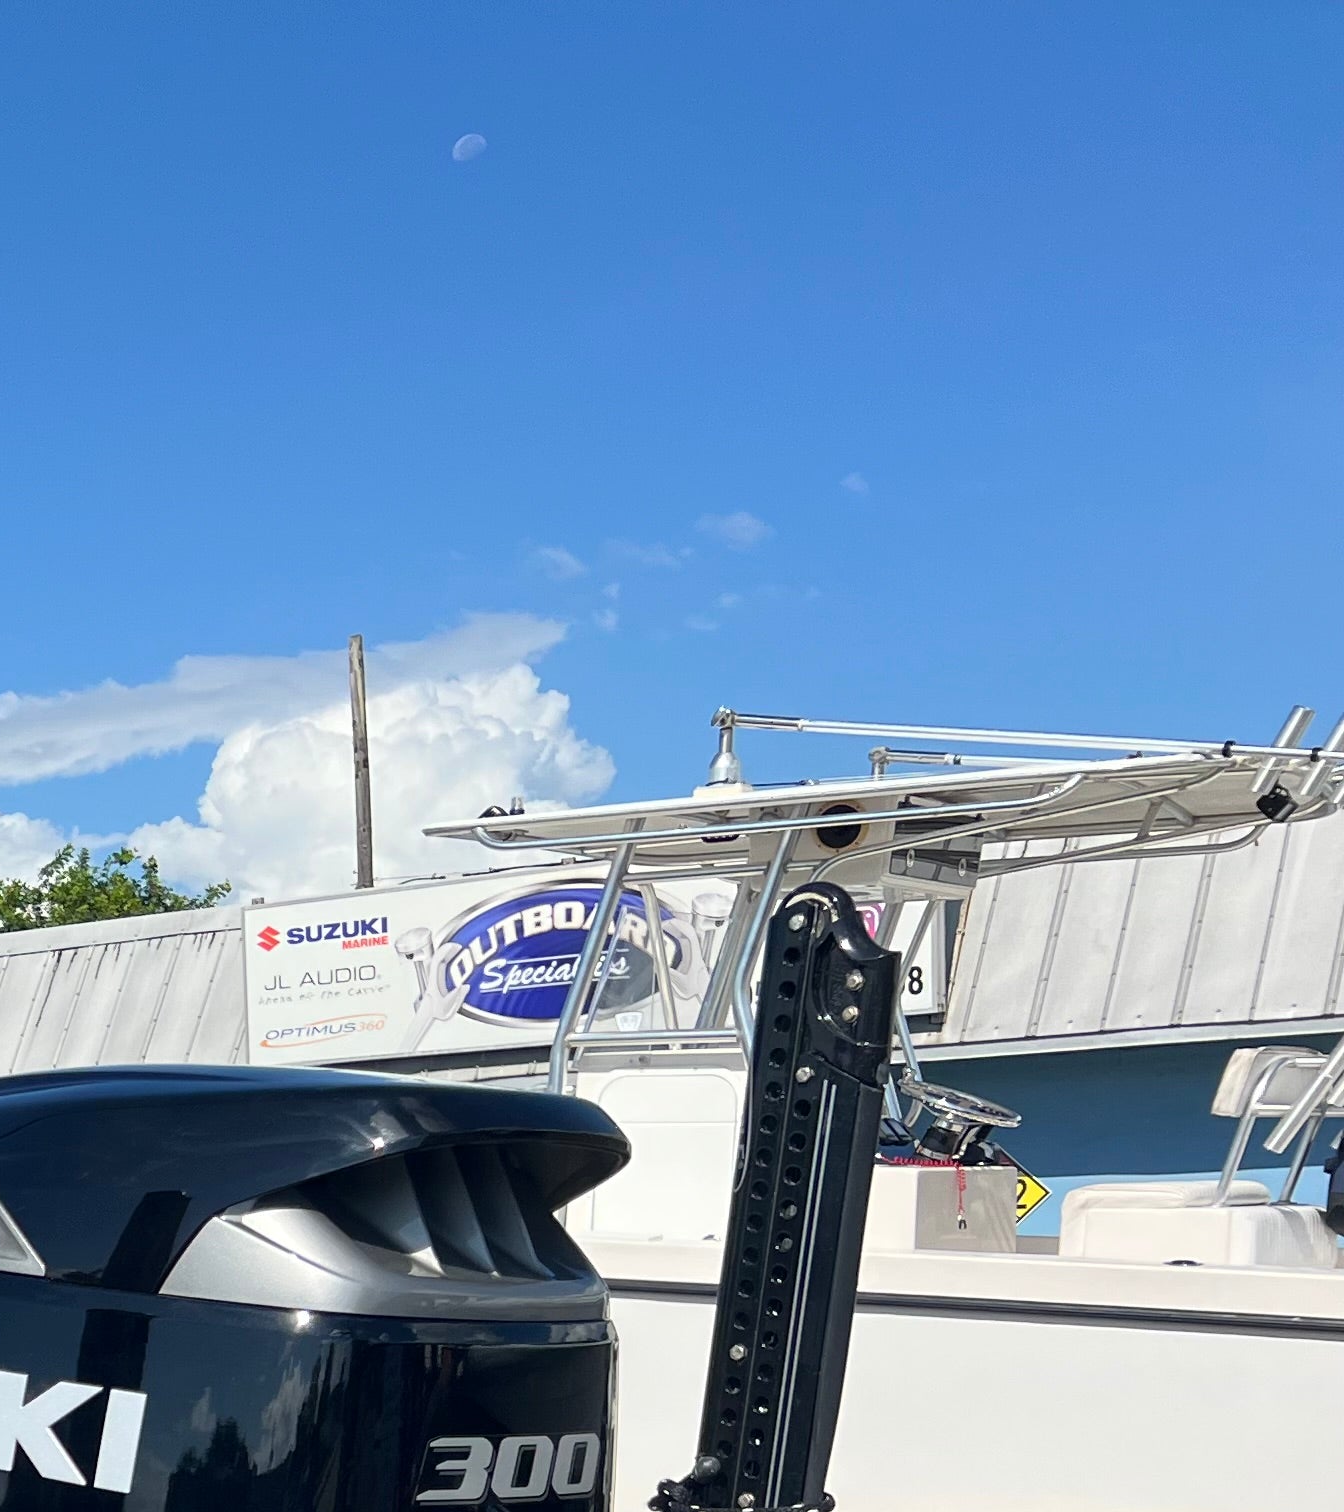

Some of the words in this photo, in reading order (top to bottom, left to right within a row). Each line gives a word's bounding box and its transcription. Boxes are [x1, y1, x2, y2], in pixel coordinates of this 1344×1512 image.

[286, 916, 389, 945] SUZUKI
[341, 935, 389, 950] MARINE
[264, 975, 291, 991] JL
[299, 965, 376, 988] AUDIO
[416, 1433, 600, 1506] 300
